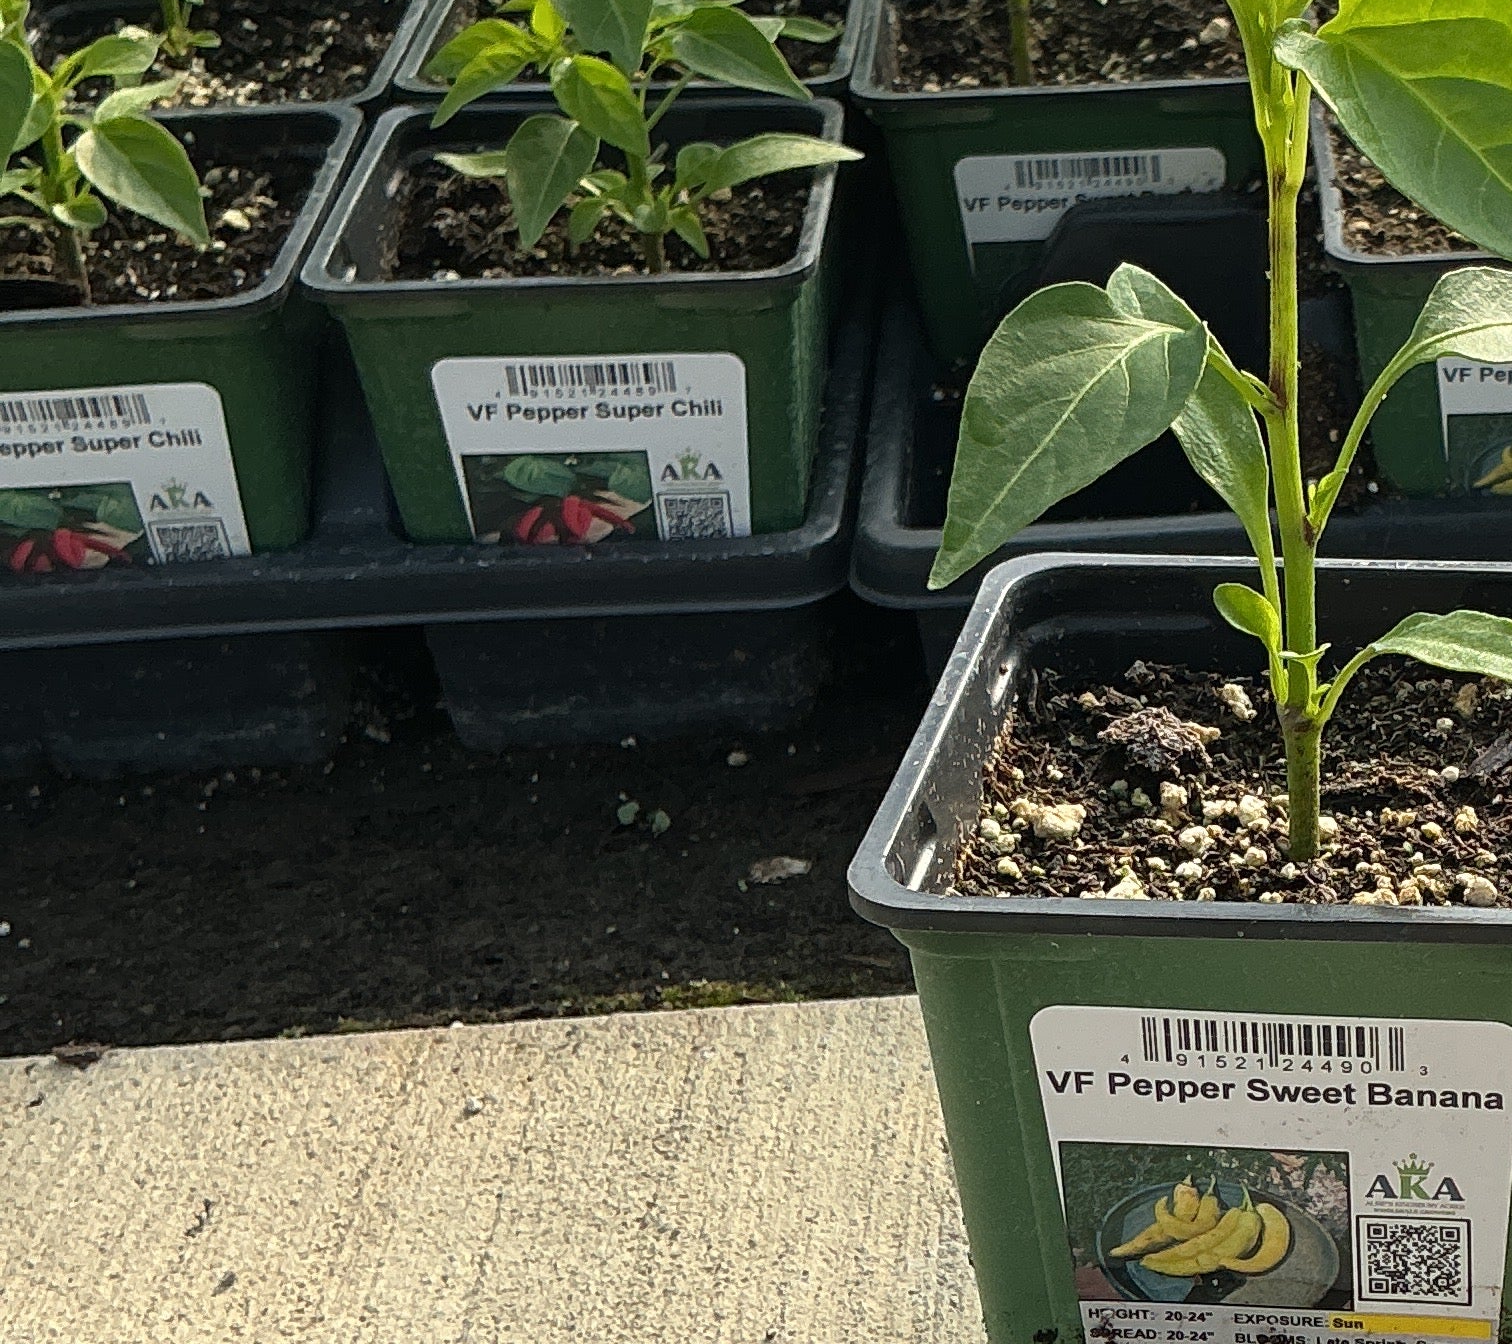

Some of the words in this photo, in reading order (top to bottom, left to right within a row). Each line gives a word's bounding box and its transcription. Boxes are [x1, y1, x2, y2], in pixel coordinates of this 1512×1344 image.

[963, 197, 990, 213] VF
[997, 196, 1069, 215] Pepper
[1443, 367, 1473, 383] VF
[467, 403, 498, 422] VF
[506, 402, 588, 424] Pepper
[595, 401, 664, 422] Super
[671, 399, 723, 418] Chili
[0, 440, 64, 459] epper
[71, 434, 141, 455] Super
[149, 428, 203, 448] Chili
[1120, 1054, 1130, 1065] 4
[1176, 1053, 1265, 1071] 91521
[1282, 1058, 1373, 1075] 24490
[1419, 1065, 1429, 1077] 3
[1046, 1071, 1094, 1094] VF
[1108, 1072, 1236, 1103] Pepper
[1246, 1078, 1357, 1106] Sweet
[1368, 1083, 1504, 1110] Banana
[1365, 1174, 1465, 1202] AKA
[1233, 1313, 1330, 1328] EXPOSURE:
[1332, 1317, 1364, 1330] Sun
